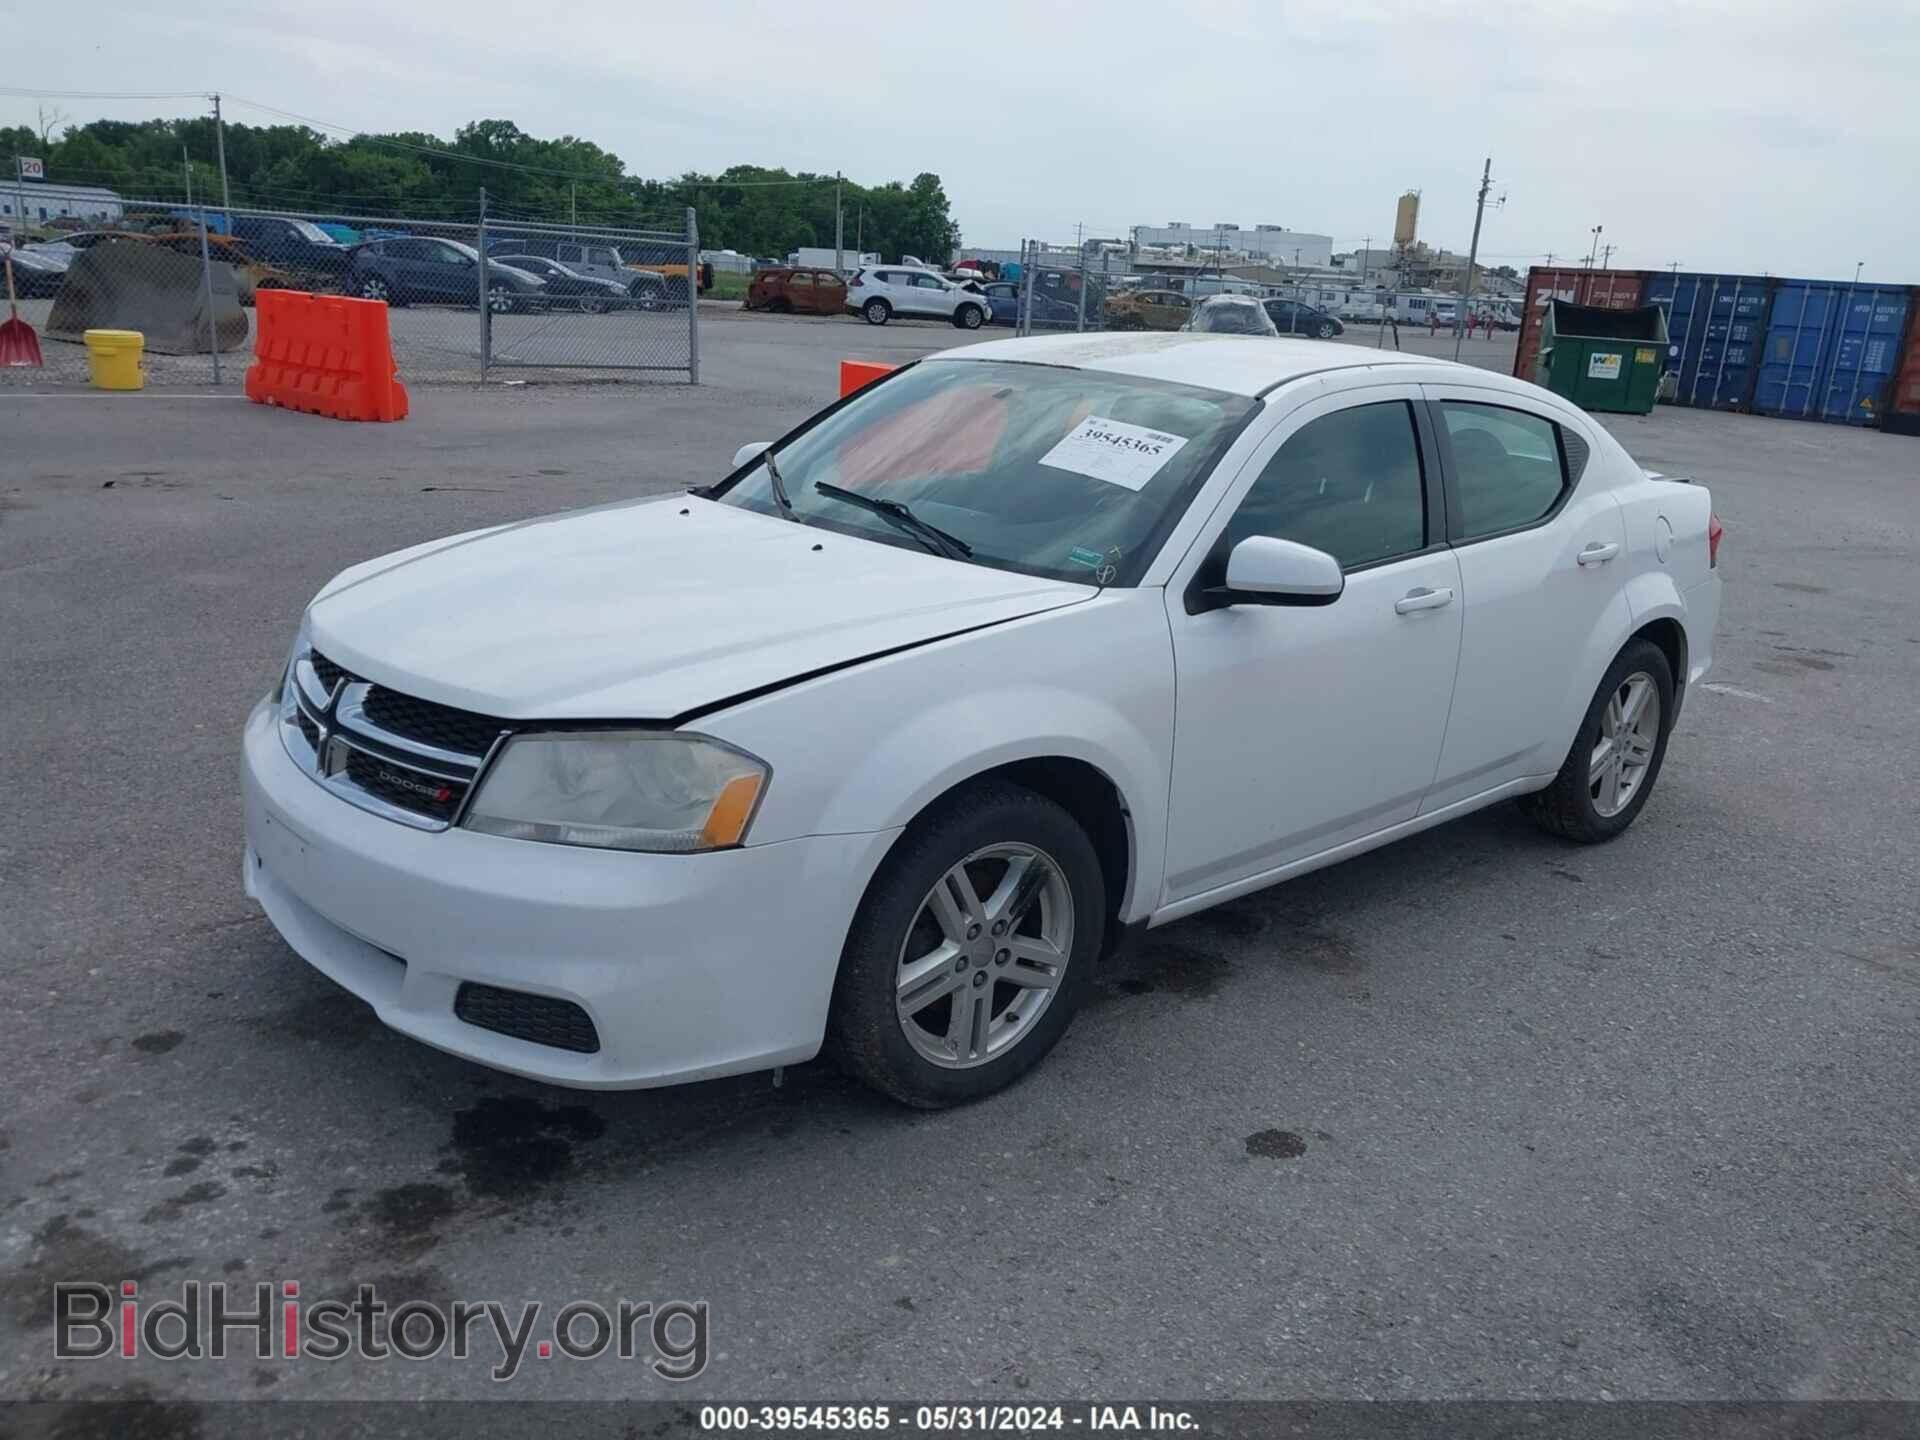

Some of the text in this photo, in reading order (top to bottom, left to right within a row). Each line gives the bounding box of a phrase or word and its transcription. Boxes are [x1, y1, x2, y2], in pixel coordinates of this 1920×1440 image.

[23, 161, 41, 174] 20
[1080, 428, 1163, 456] 39545365
[380, 770, 436, 796] DODGE
